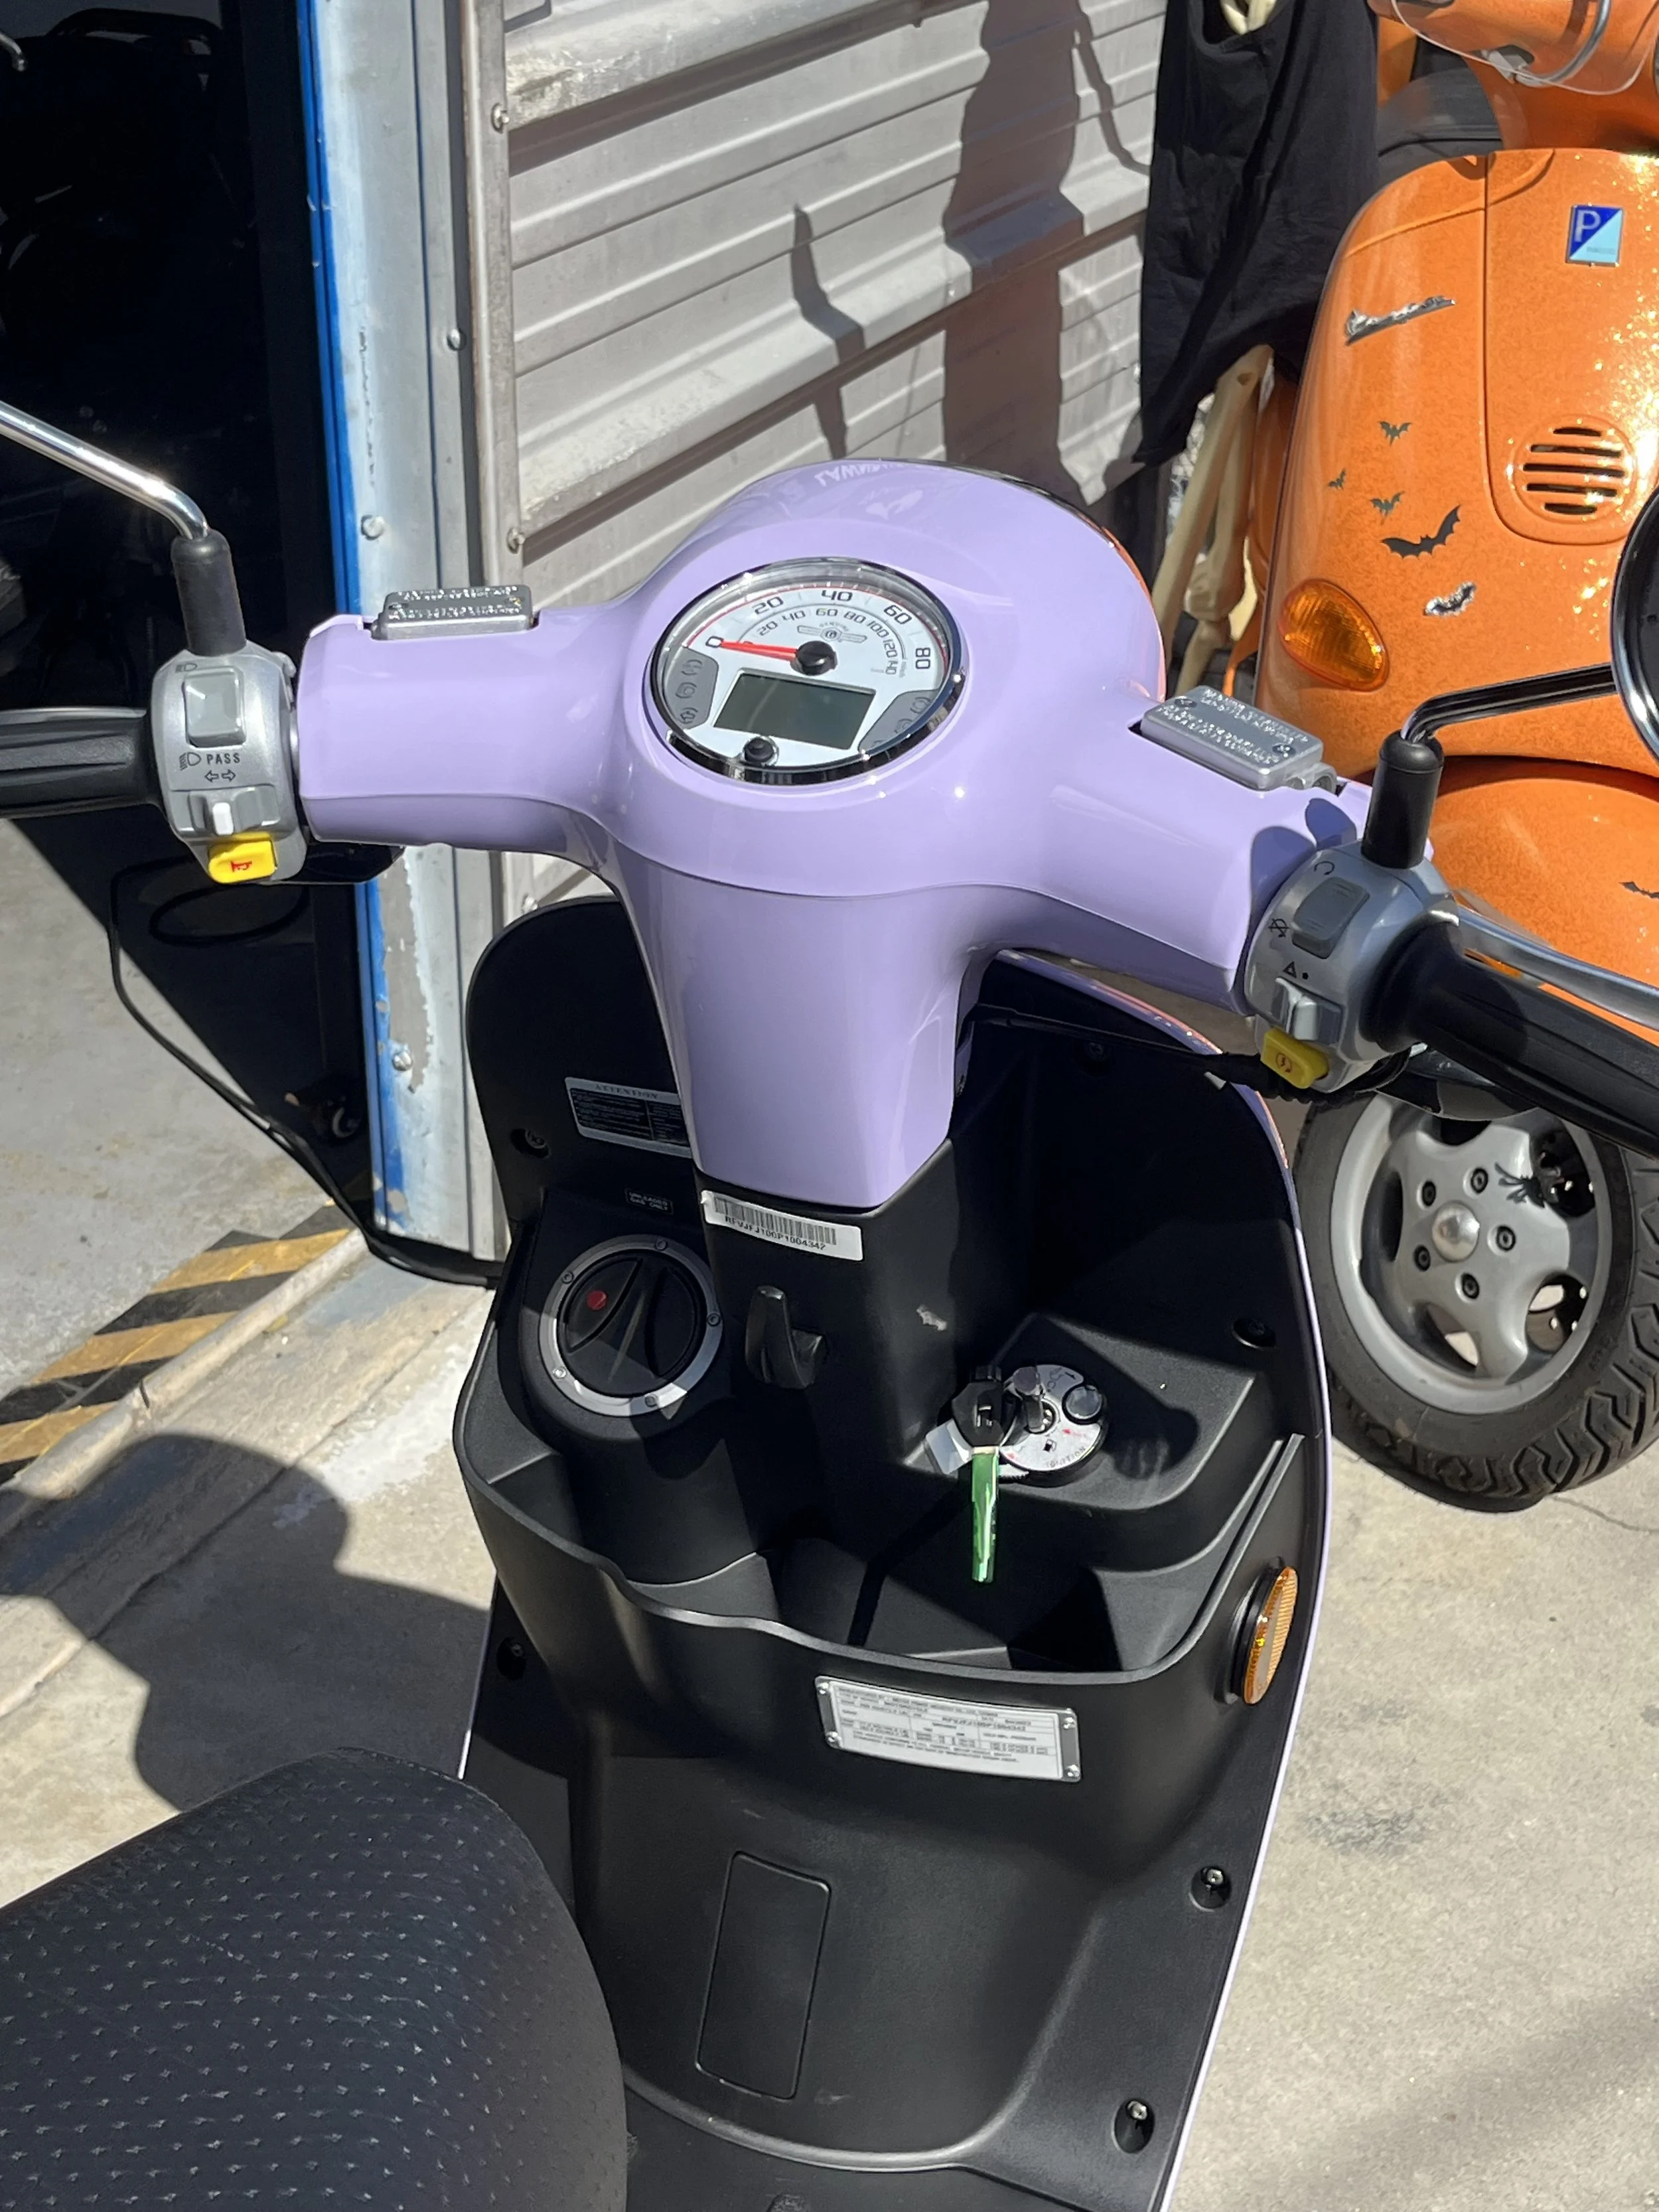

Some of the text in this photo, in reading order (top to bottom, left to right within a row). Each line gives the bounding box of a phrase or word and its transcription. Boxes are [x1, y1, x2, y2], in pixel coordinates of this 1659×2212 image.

[1574, 210, 1601, 242] P
[821, 589, 853, 602] 40
[752, 596, 784, 615] 20
[816, 608, 838, 617] 60
[782, 610, 806, 621] 40
[843, 611, 867, 624] 80
[883, 605, 913, 625] 60
[758, 621, 779, 636] 20
[866, 621, 890, 638] 100
[705, 636, 725, 648] 0
[883, 639, 899, 658] 120
[915, 647, 932, 670] 80
[206, 753, 240, 765] PASS
[594, 1084, 658, 1100] ATTENTION
